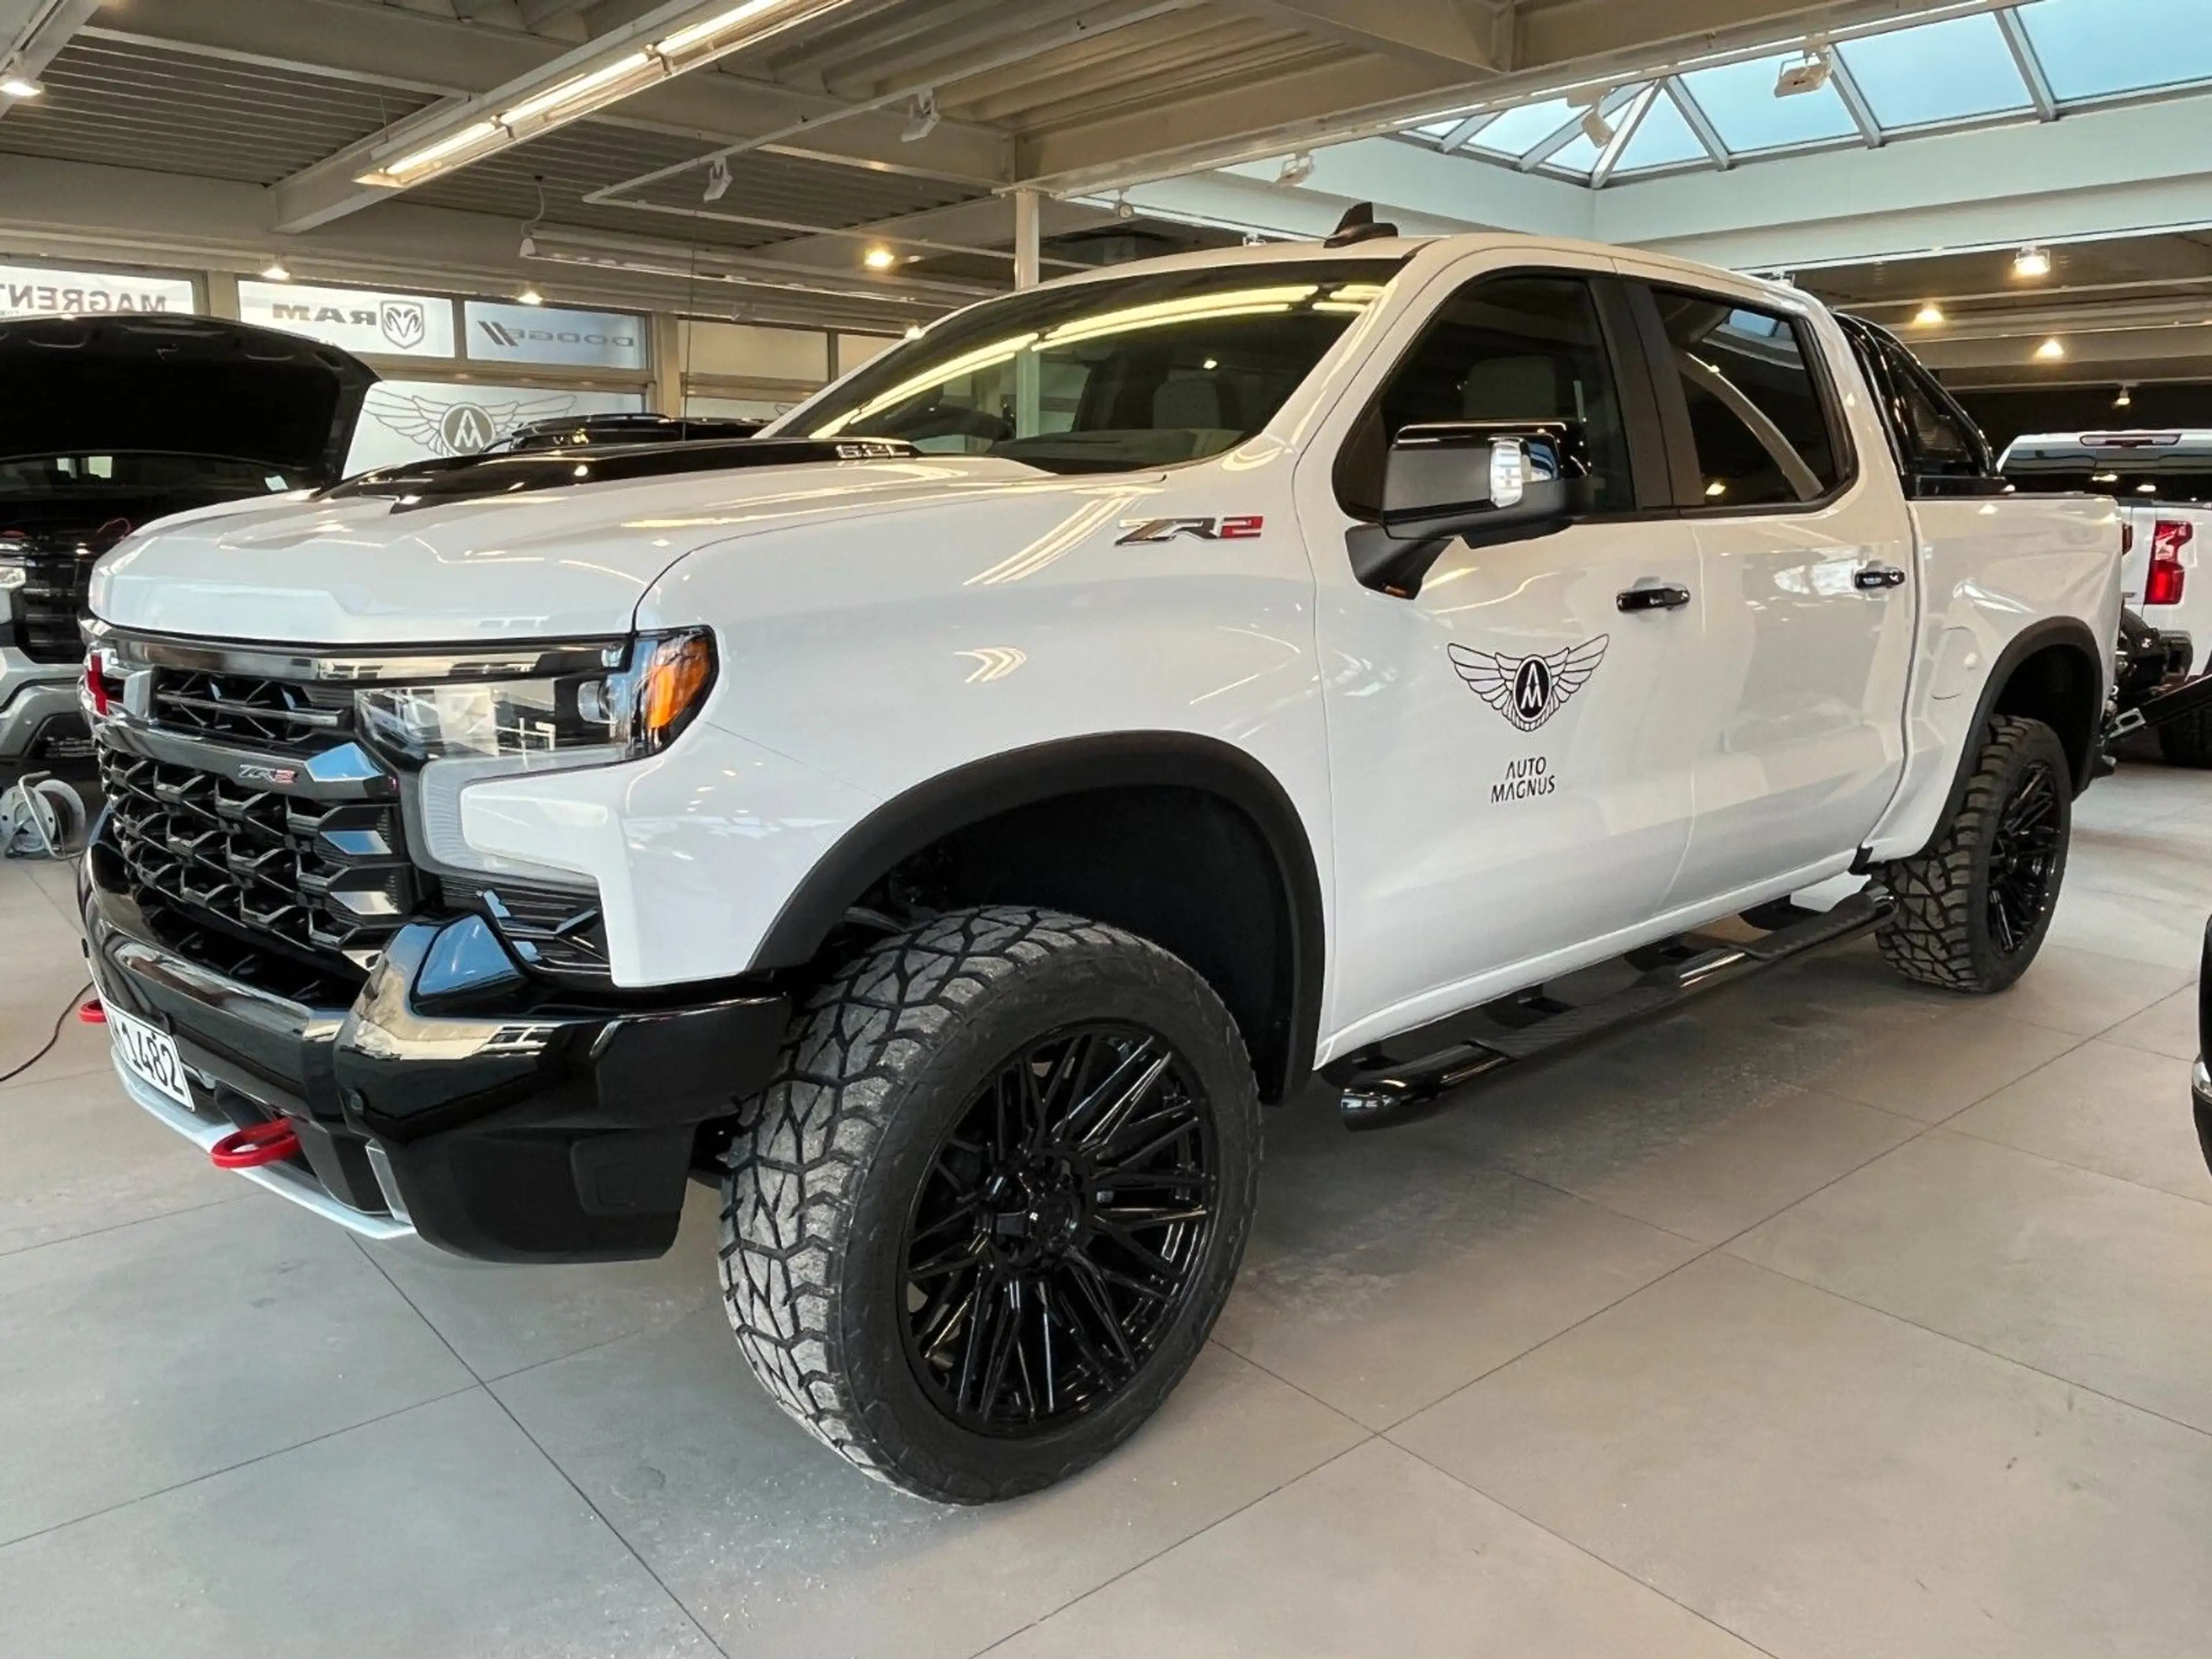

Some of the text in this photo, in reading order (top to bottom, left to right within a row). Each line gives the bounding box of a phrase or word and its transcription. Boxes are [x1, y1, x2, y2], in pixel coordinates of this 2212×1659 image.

[1114, 516, 1263, 547] ZR2
[238, 764, 298, 784] ZR2
[1505, 756, 1547, 781] AUTO
[1491, 775, 1555, 804] MAGNUS
